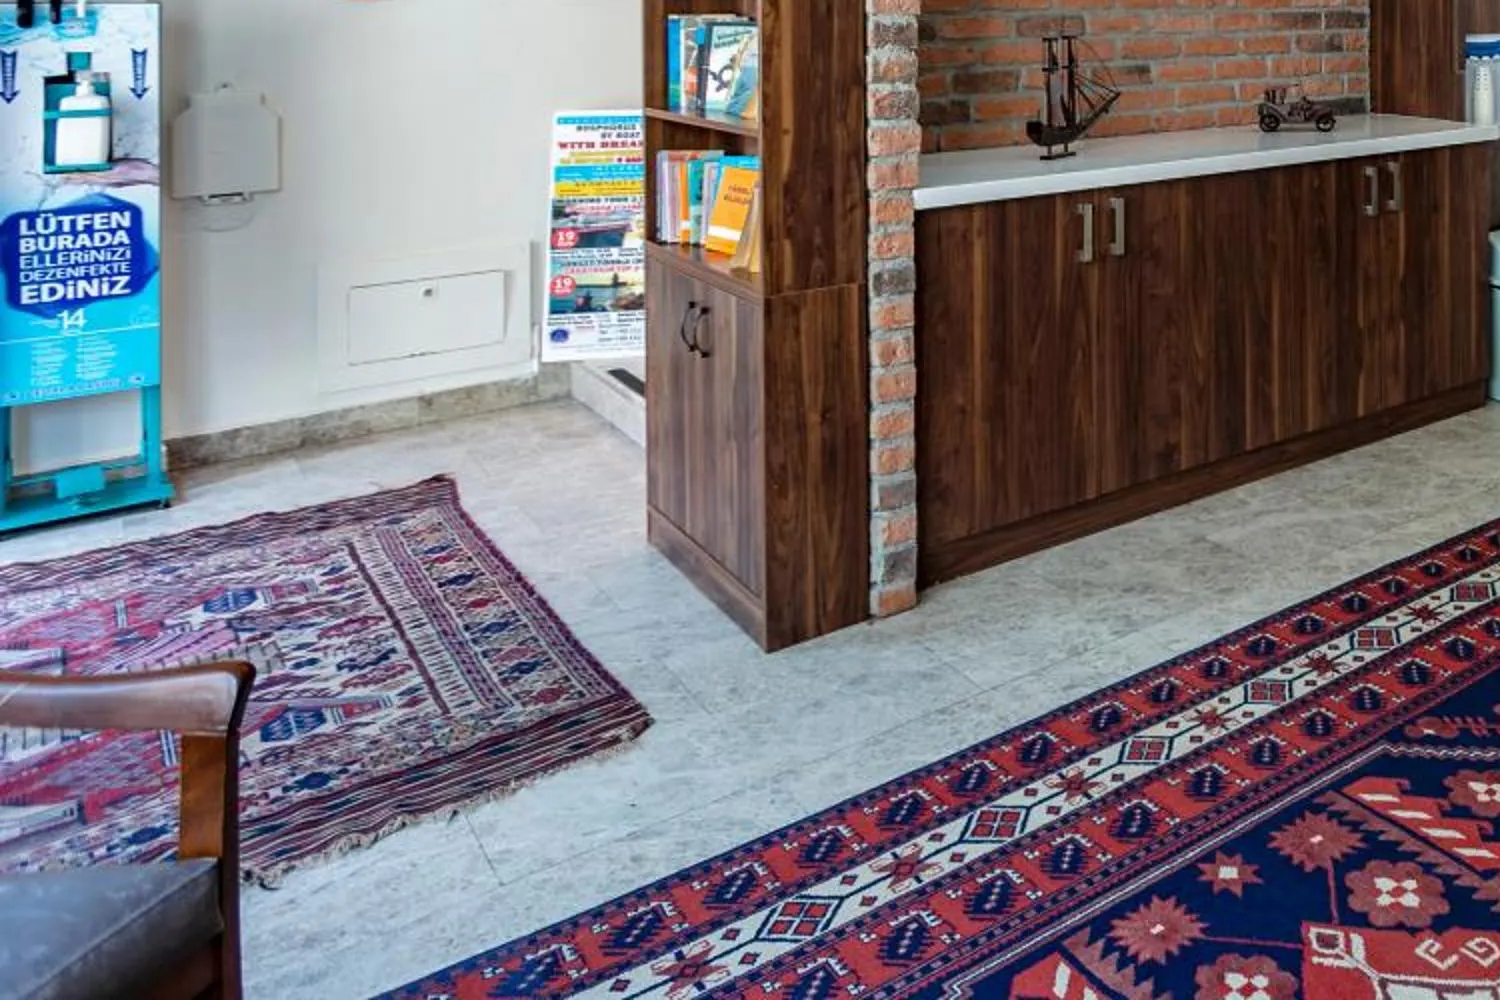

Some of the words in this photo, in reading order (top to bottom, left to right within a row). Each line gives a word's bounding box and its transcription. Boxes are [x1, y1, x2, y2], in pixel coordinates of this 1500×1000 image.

[19, 211, 132, 237] LÜTFEN
[19, 229, 131, 254] BURADA
[19, 261, 132, 283] DEZENFEKTE
[56, 308, 86, 329] 14
